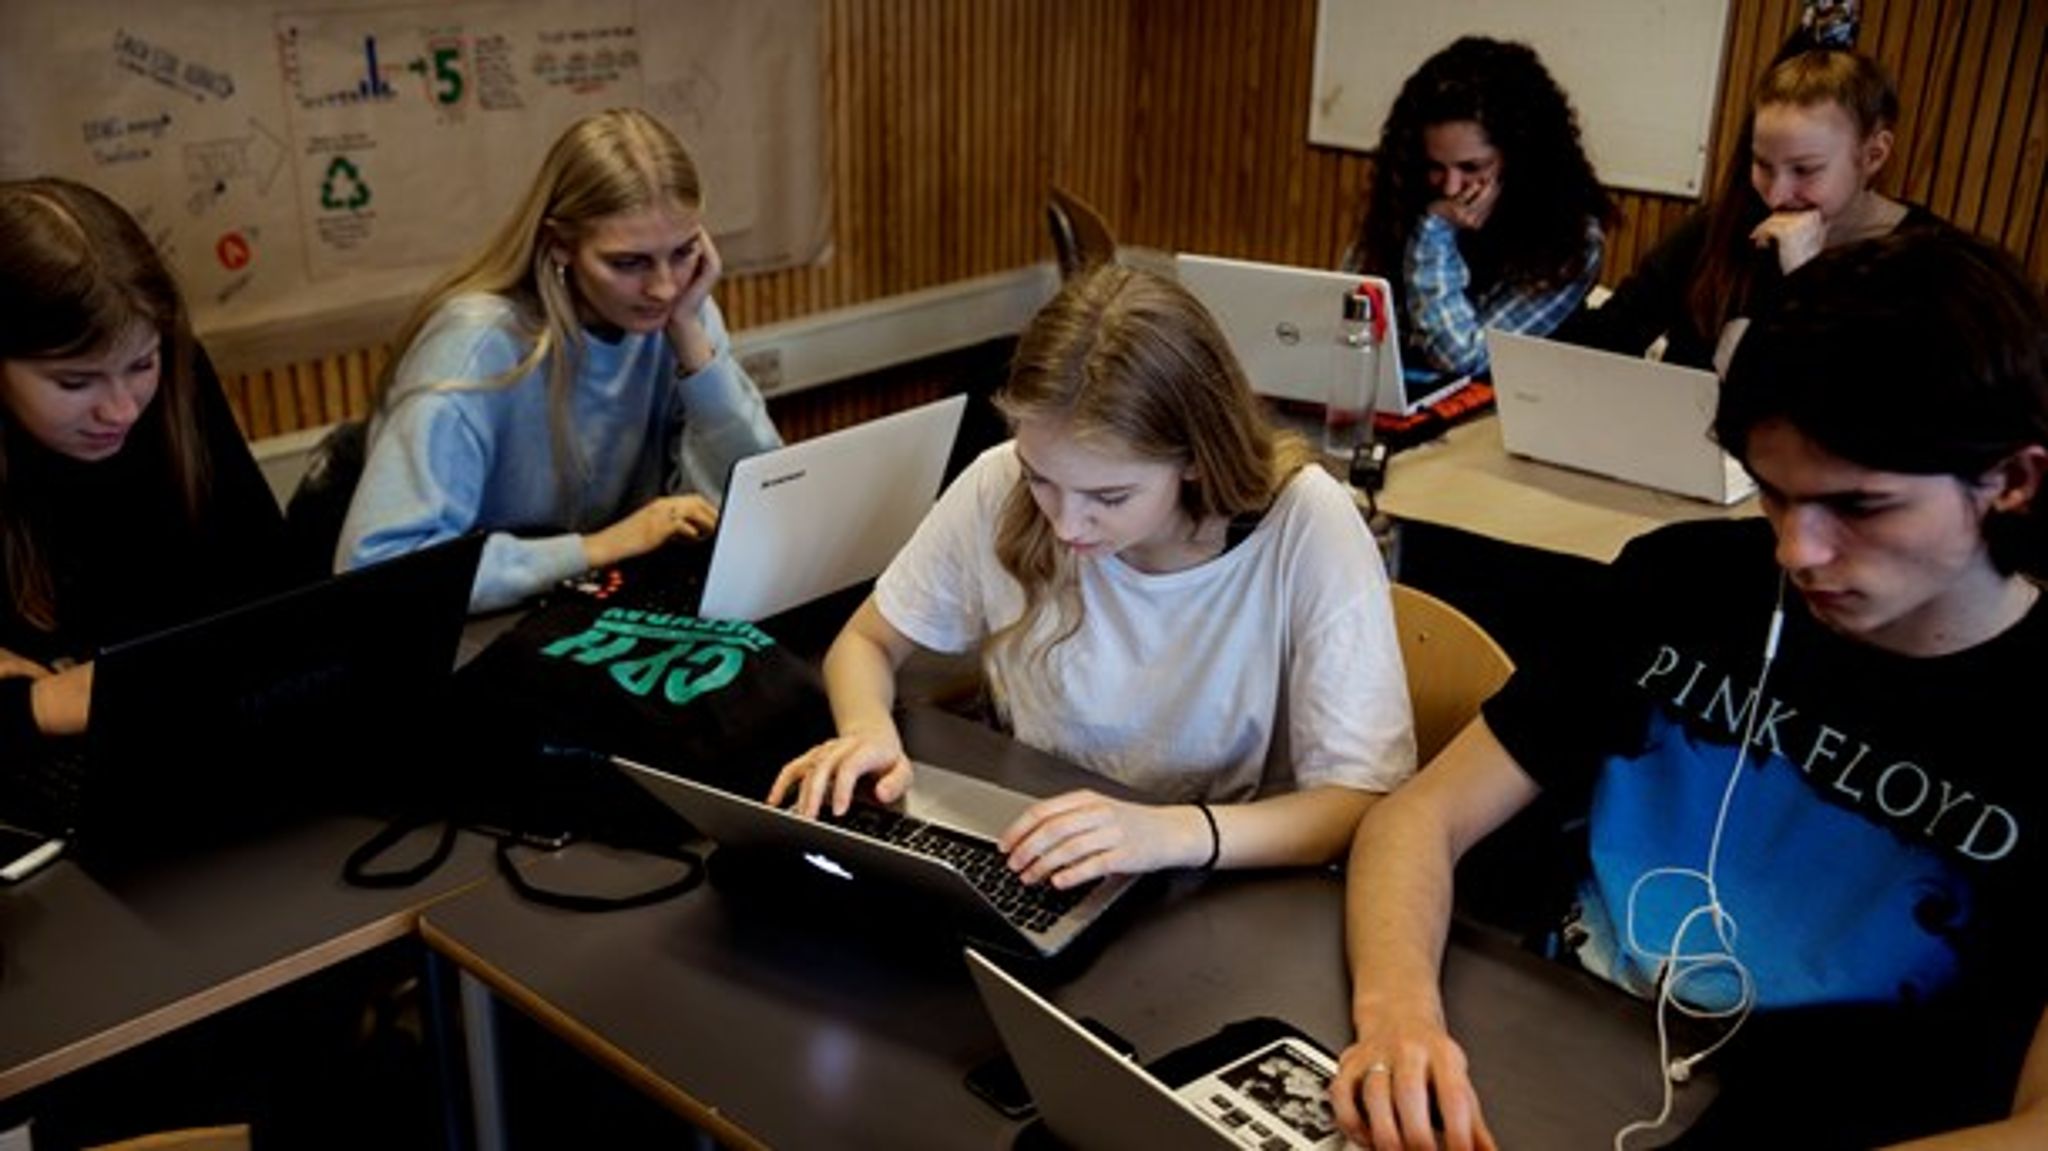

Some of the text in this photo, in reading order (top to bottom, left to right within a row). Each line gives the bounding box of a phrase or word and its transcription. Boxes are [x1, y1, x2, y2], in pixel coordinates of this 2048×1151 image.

[434, 47, 463, 105] 5
[1637, 645, 2019, 861] PINK FLOYD
